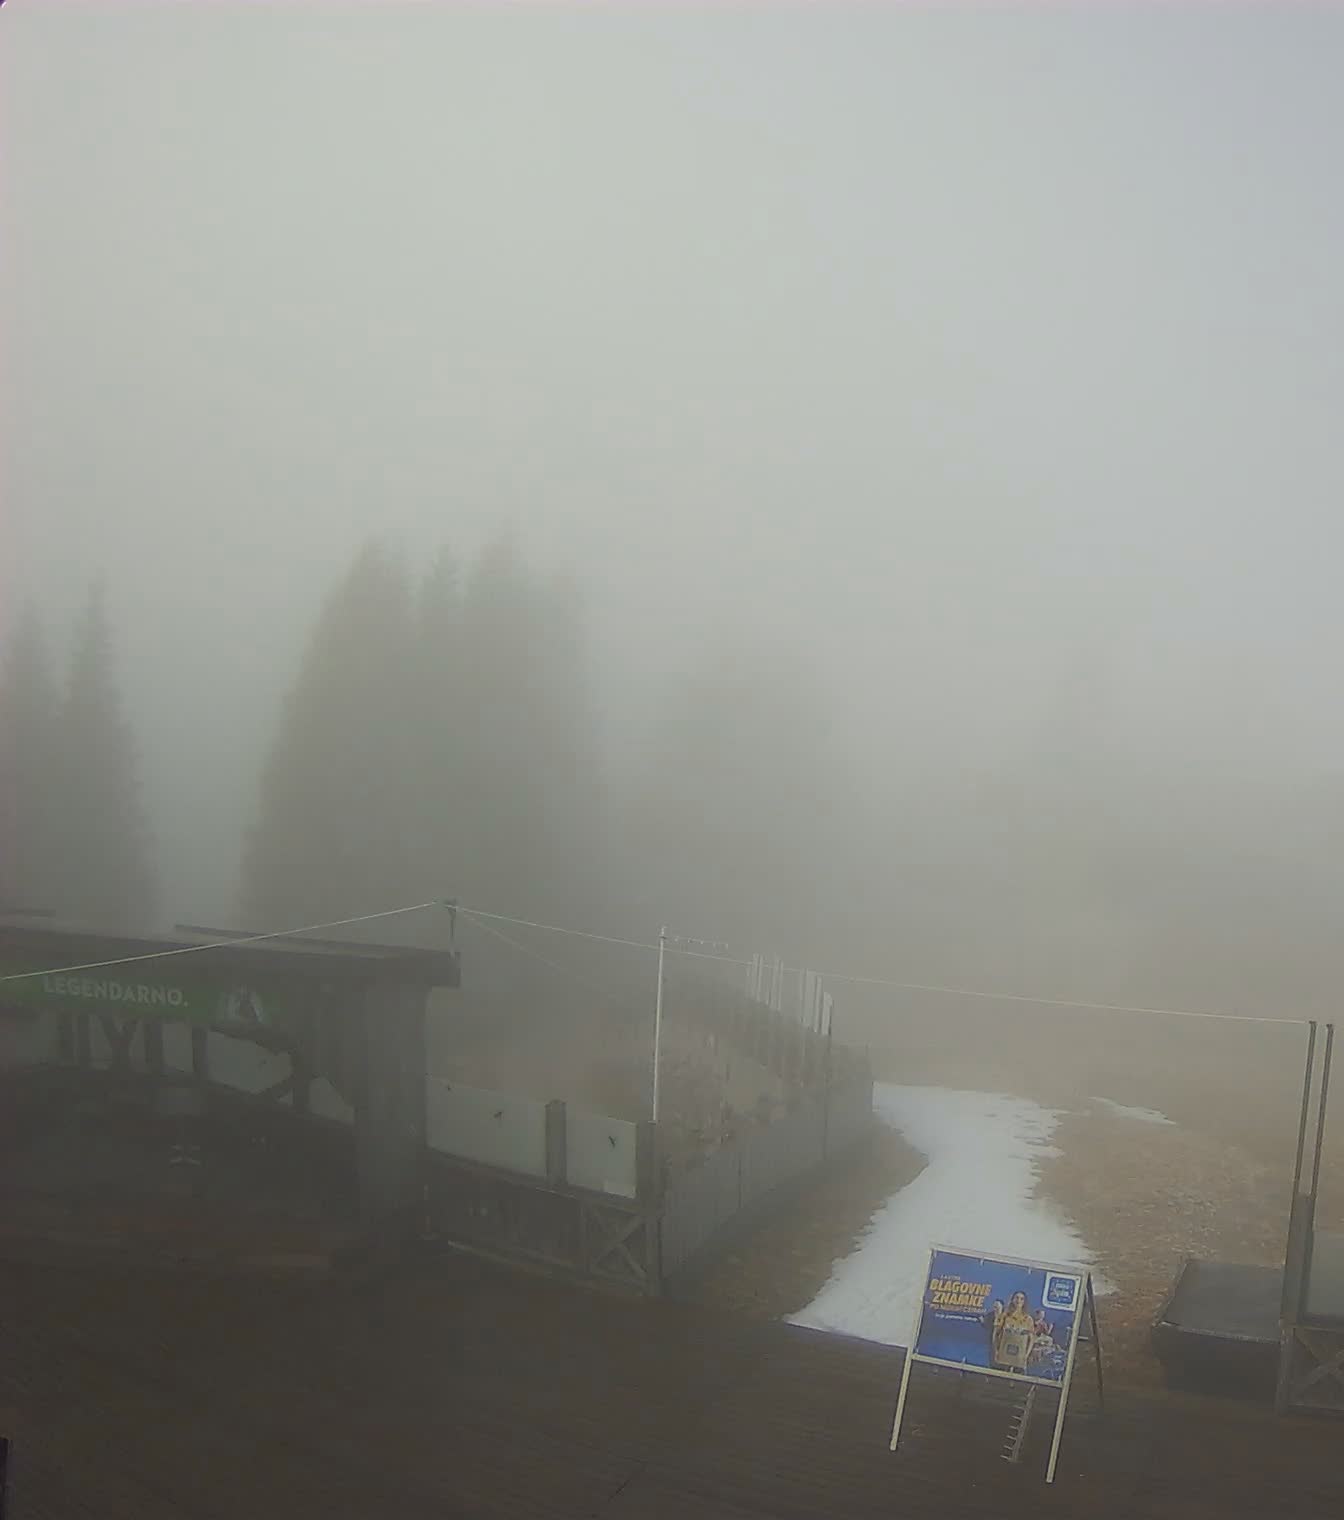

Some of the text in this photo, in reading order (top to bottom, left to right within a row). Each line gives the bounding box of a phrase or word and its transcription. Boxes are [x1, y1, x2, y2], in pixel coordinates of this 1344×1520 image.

[43, 976, 188, 1007] LEGENDARNO.
[930, 1279, 992, 1296] BLAGOVNE
[932, 1291, 984, 1307] ZNAMKE
